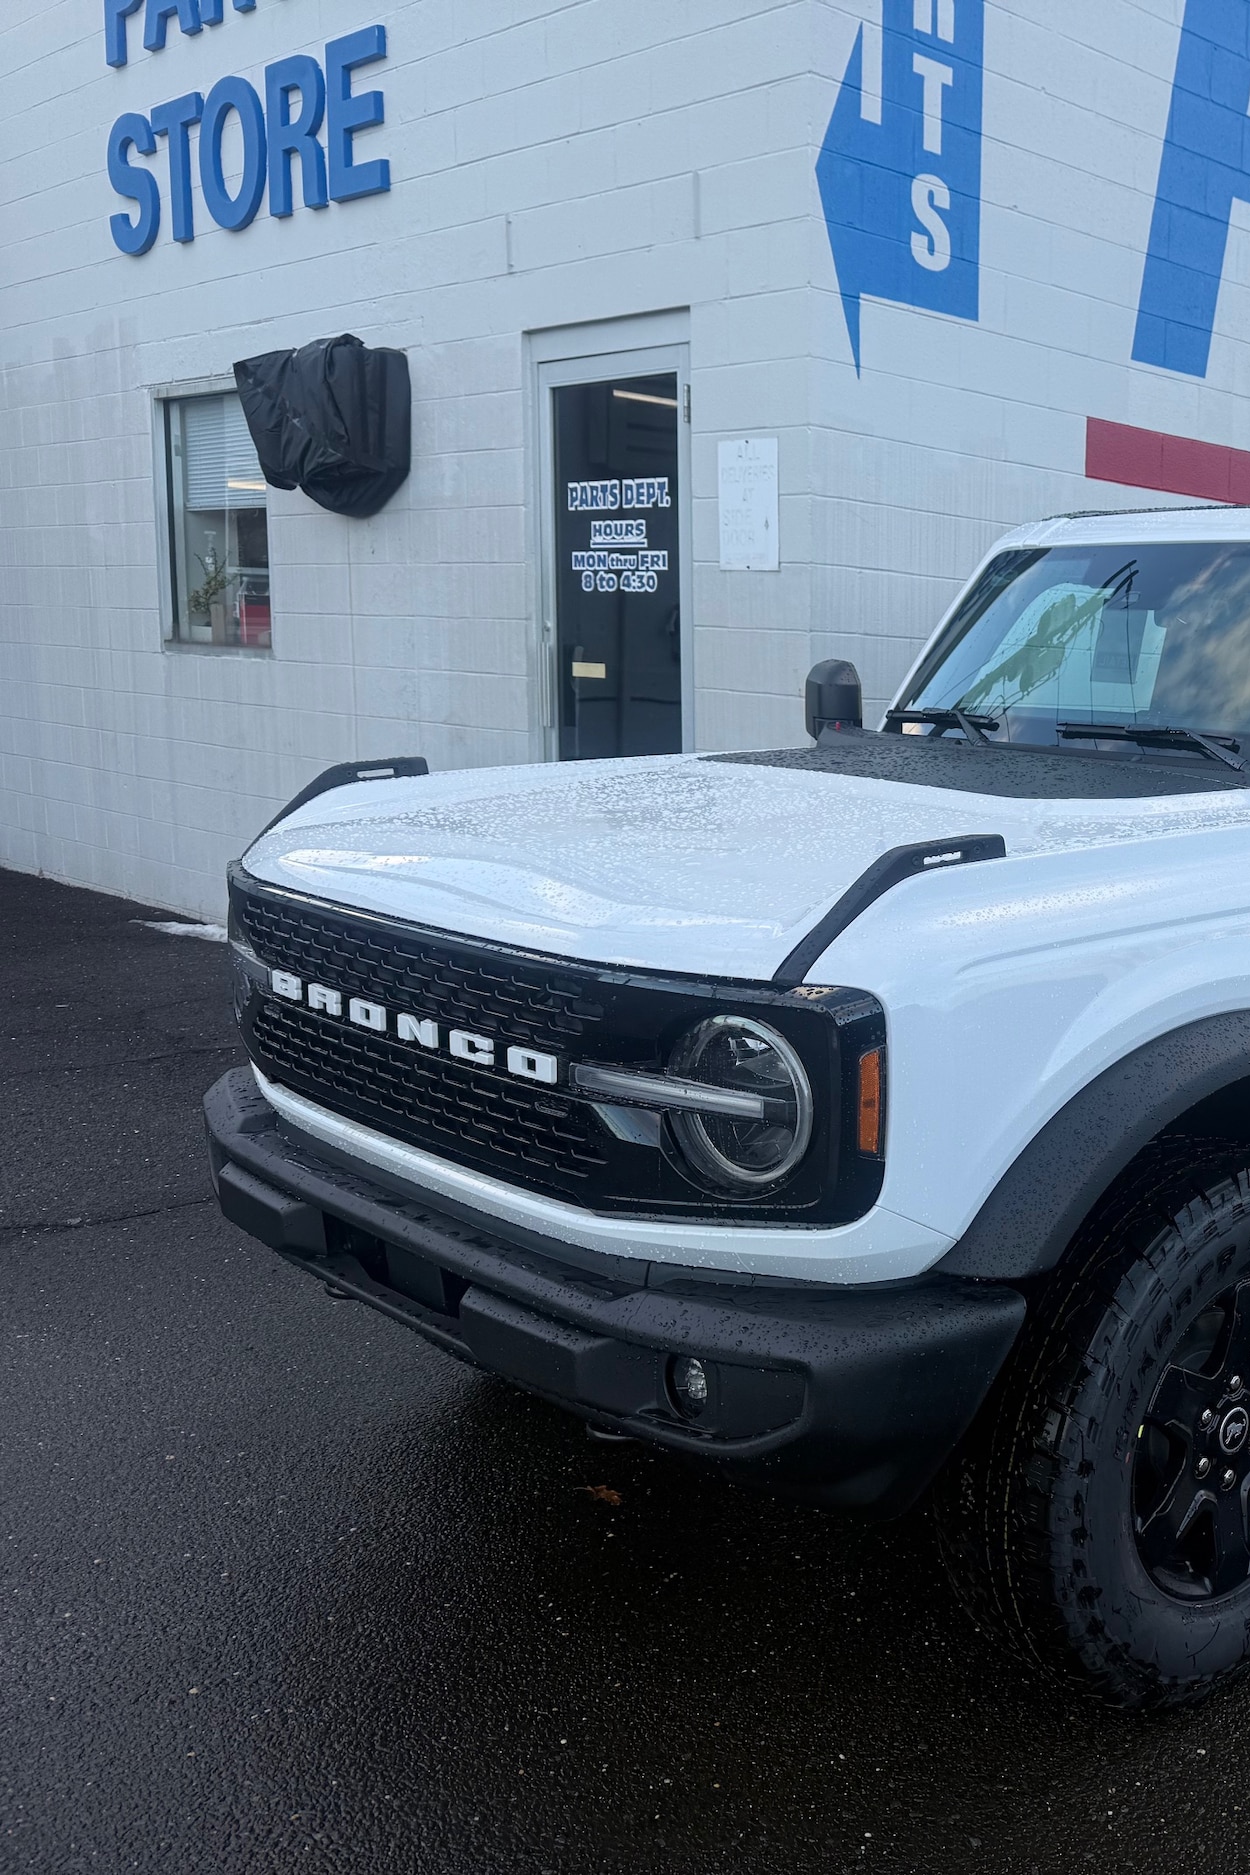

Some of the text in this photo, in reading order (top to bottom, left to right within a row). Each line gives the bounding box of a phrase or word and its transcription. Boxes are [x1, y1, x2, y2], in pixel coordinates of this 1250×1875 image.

[107, 25, 390, 256] STORE
[735, 444, 760, 461] ALL
[568, 477, 671, 511] PARTS DEPT.
[591, 519, 646, 540] HOURS
[572, 550, 668, 570] MON thru FRI
[582, 571, 658, 592] 8 to 4:30
[272, 969, 558, 1086] BRONCO
